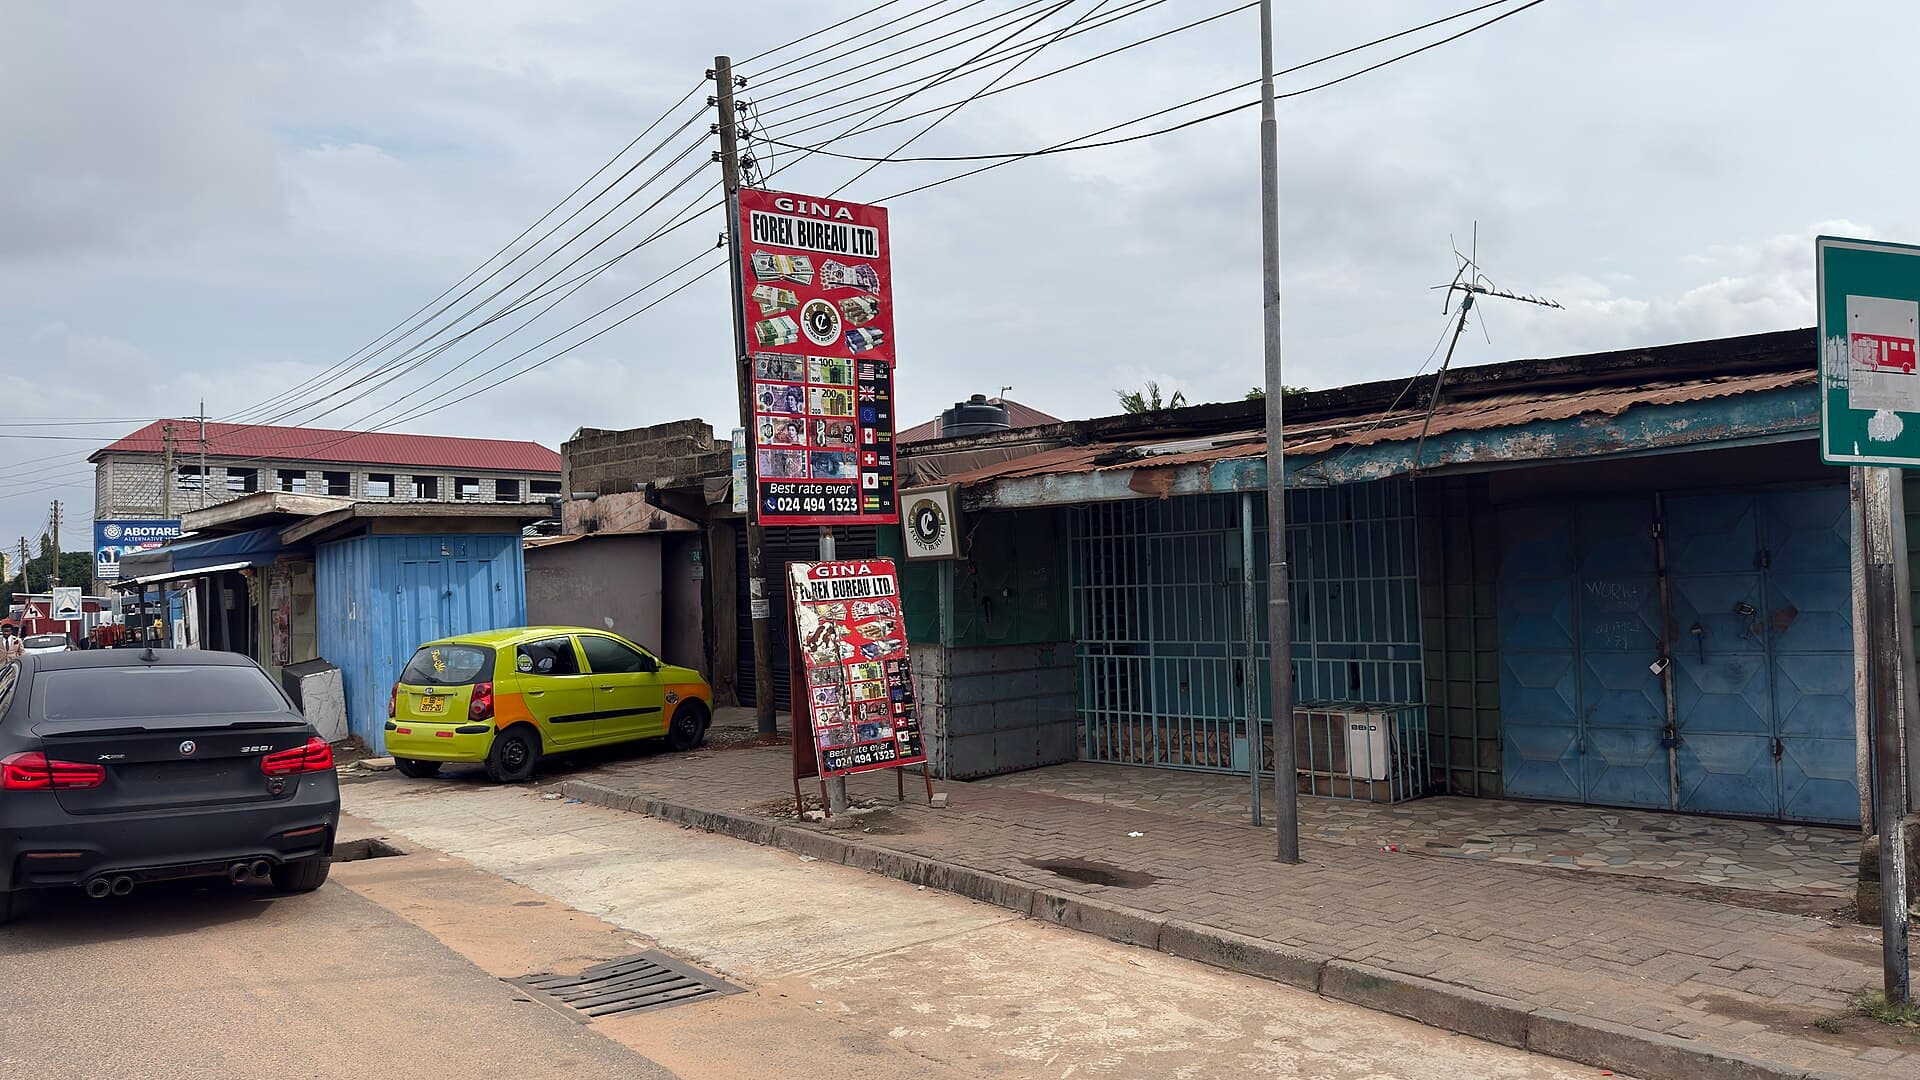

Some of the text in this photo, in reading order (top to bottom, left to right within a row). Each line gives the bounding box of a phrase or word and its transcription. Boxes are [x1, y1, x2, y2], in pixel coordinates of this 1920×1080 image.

[775, 198, 855, 222] GINA
[753, 213, 878, 256] FOREX BUREAU LTD.
[819, 358, 833, 367] 100
[821, 389, 836, 398] 200
[844, 433, 854, 443] 50
[770, 483, 851, 495] Best rate ever
[777, 497, 857, 512] 024 494 1323
[123, 527, 179, 536] ABOTARE
[815, 564, 872, 577] GINA
[832, 578, 870, 598] BUREAU
[872, 577, 894, 595] LTD.
[835, 749, 895, 768] 024 494 1323
